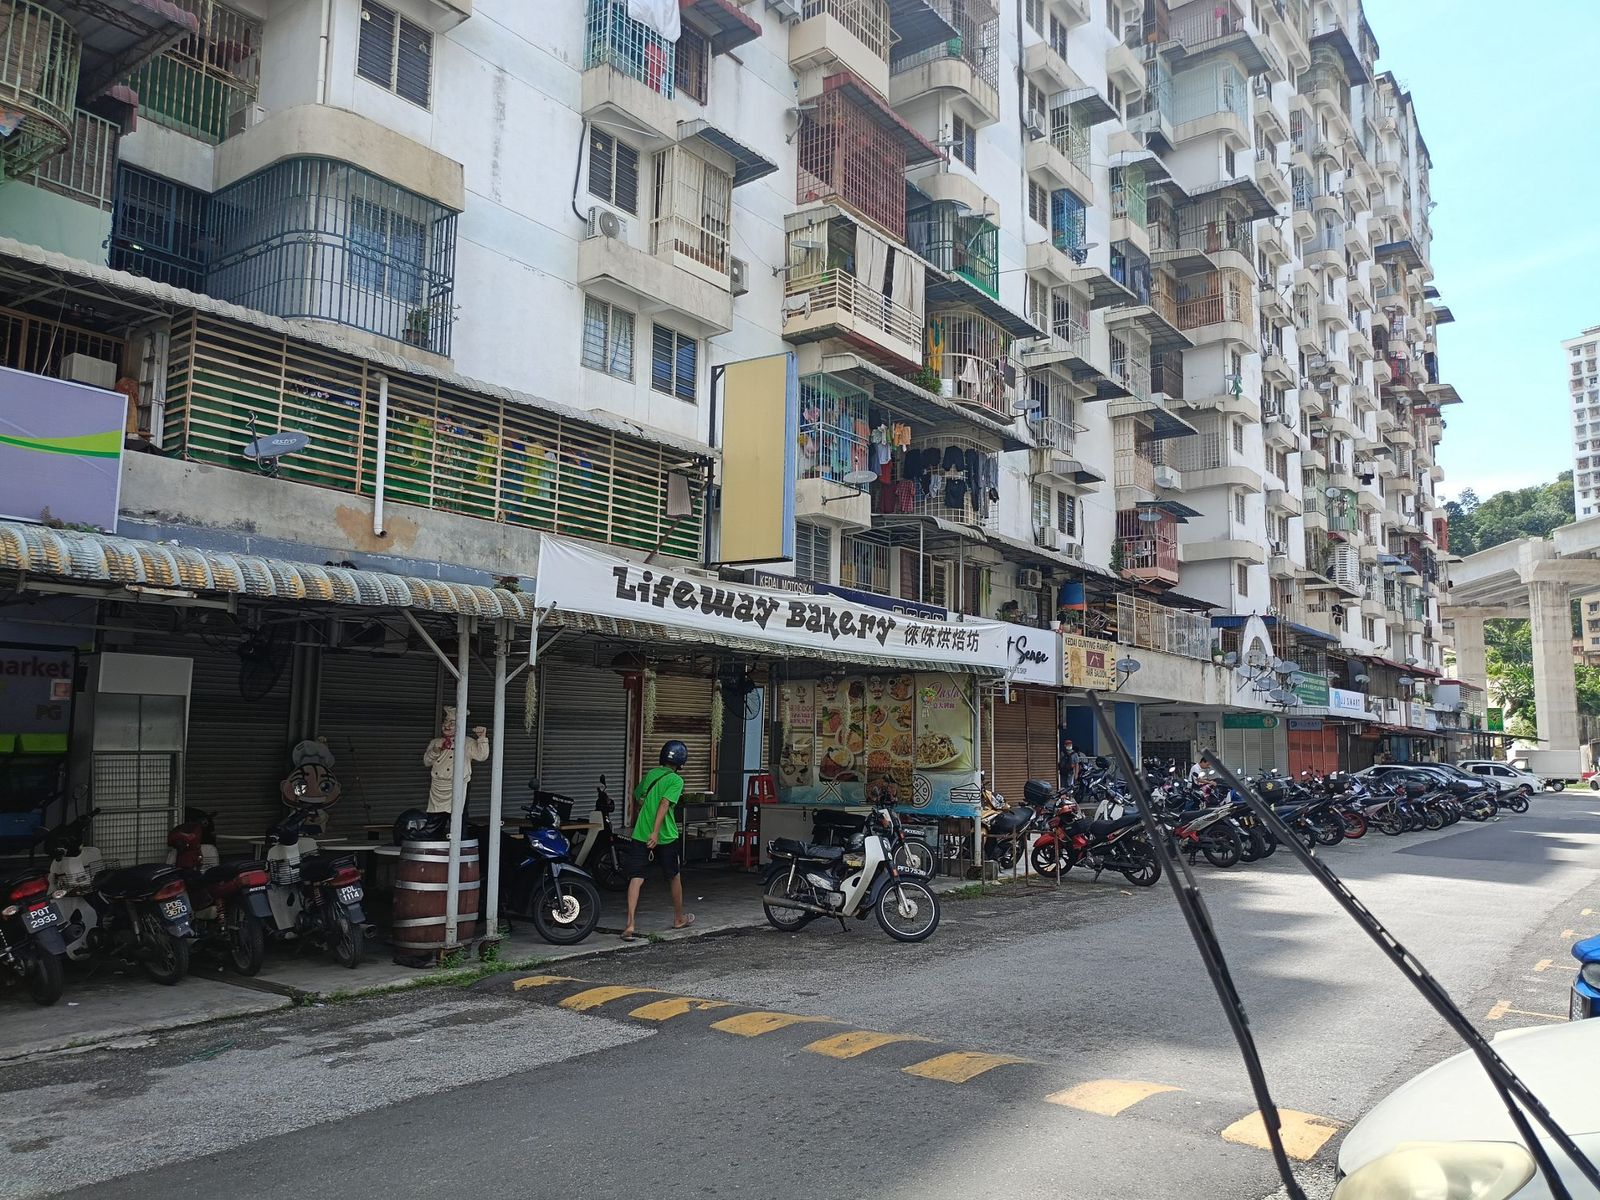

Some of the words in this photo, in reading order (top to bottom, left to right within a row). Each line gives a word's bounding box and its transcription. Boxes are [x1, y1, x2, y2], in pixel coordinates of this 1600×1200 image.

[272, 438, 297, 446] astro
[759, 574, 778, 589] KEDAI
[612, 566, 780, 631] Lifeway
[785, 601, 897, 647] Bakery
[1016, 635, 1049, 664] Sense
[1065, 637, 1077, 647] KEDAI
[1078, 639, 1096, 650] GUNTING
[341, 885, 357, 894] PDL
[343, 891, 360, 901] 1114
[30, 906, 49, 919] PQT
[30, 913, 57, 929] 2933
